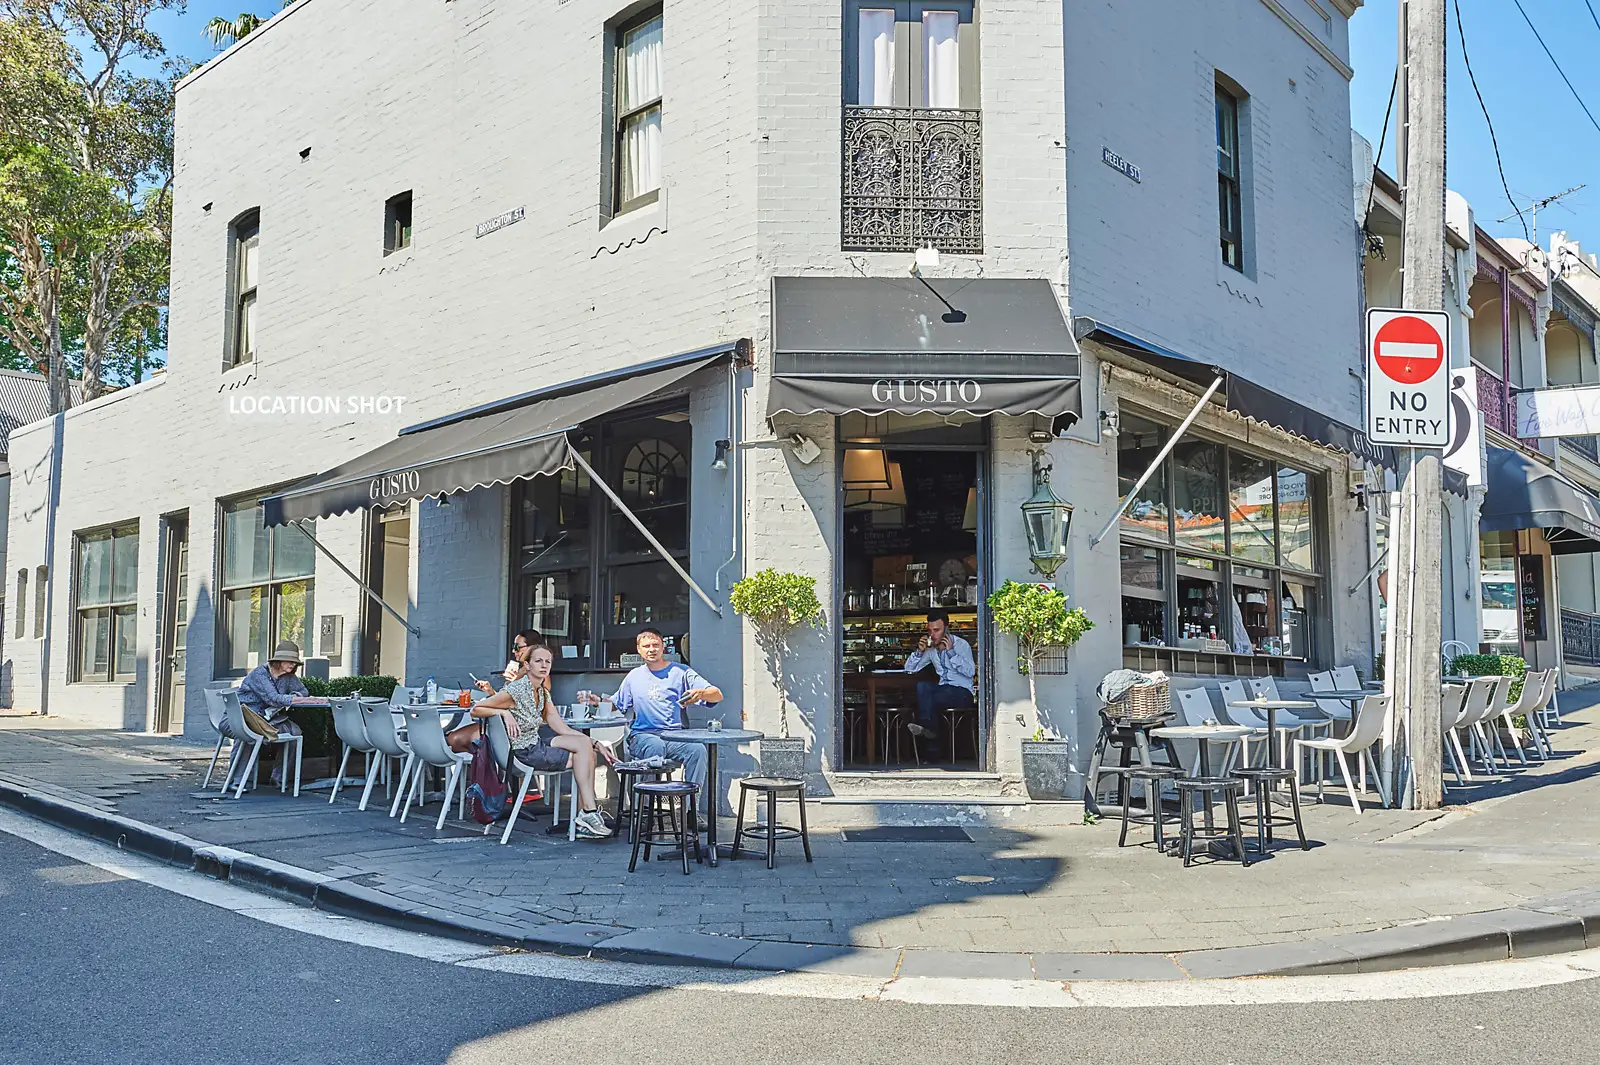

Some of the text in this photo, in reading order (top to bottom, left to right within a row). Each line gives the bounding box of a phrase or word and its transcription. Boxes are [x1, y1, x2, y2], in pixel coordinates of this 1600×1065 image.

[1105, 150, 1128, 173] HEELEY
[478, 212, 512, 235] BROUGHTON
[871, 379, 982, 403] GUSTO
[1390, 391, 1428, 412] NO
[1375, 417, 1442, 436] ENTRY
[369, 470, 420, 500] GUSTO
